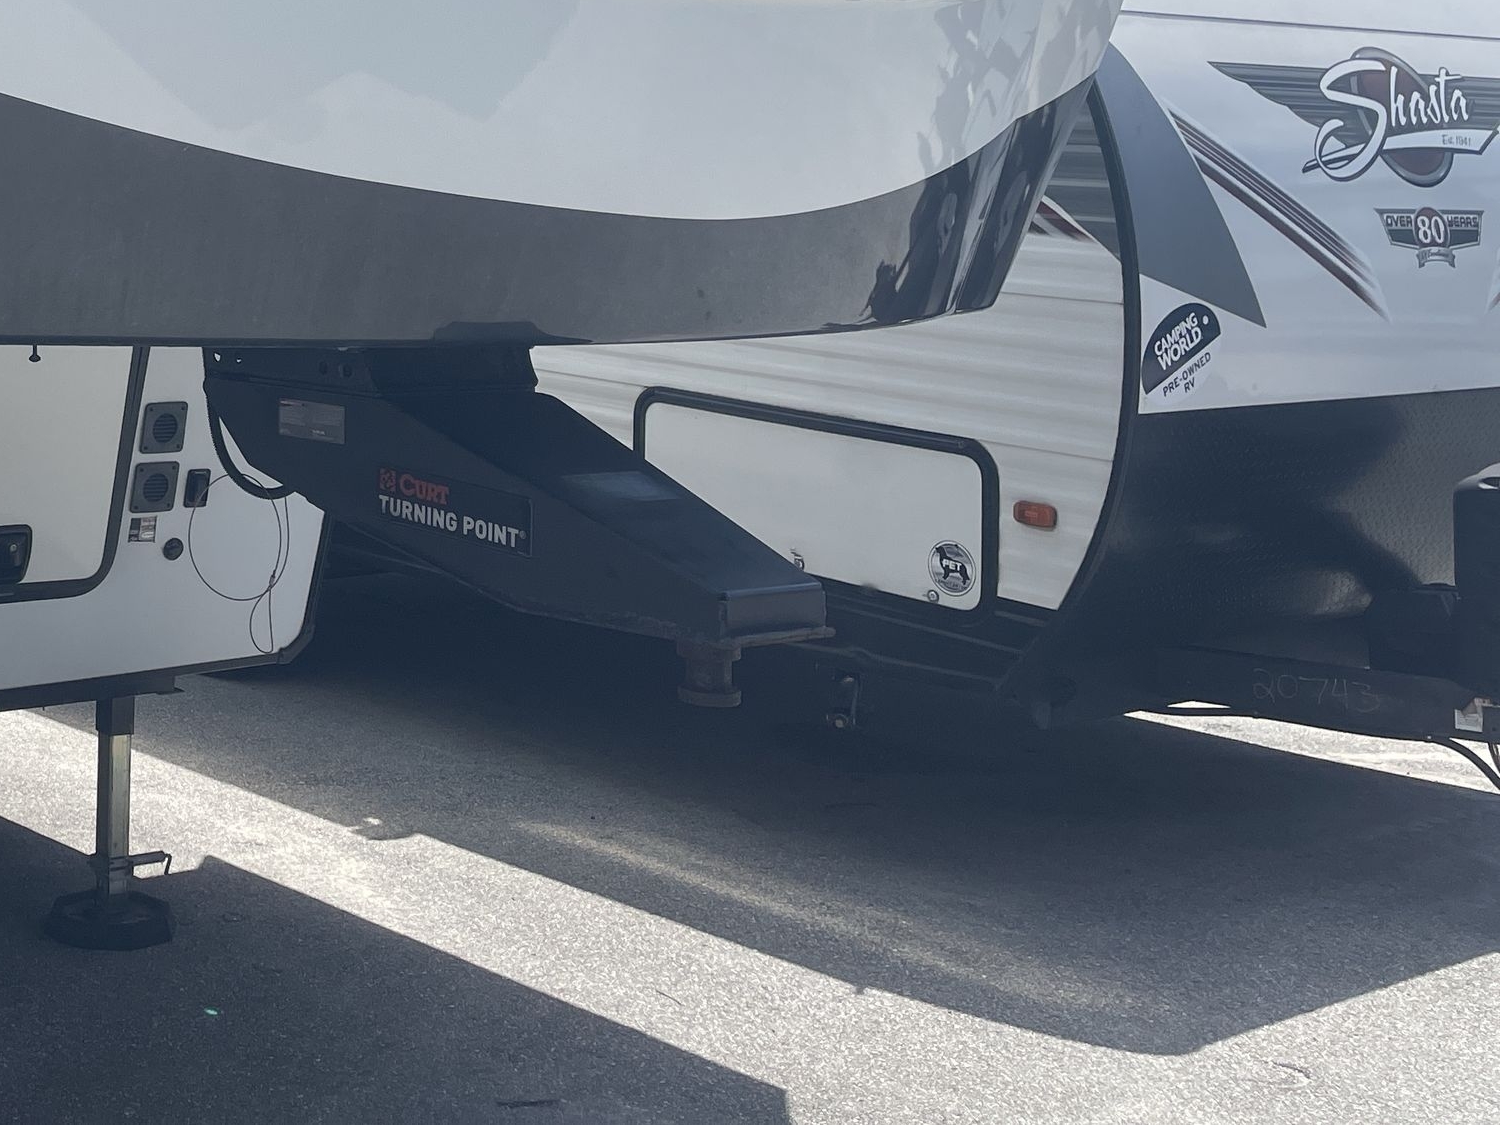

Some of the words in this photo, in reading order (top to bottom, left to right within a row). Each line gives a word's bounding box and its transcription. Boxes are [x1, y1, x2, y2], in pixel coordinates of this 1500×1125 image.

[1315, 58, 1469, 179] Shasta
[1385, 215, 1412, 227] OVER
[1417, 216, 1445, 244] 80
[1446, 215, 1478, 228] YEARS
[1154, 312, 1198, 356] CAMPING
[1157, 327, 1202, 371] WORLD
[1162, 352, 1211, 397] PRE-OWNED
[1183, 377, 1195, 393] RV
[378, 494, 458, 532] TURNING
[941, 558, 962, 572] PET
[1252, 667, 1381, 713] 20743
